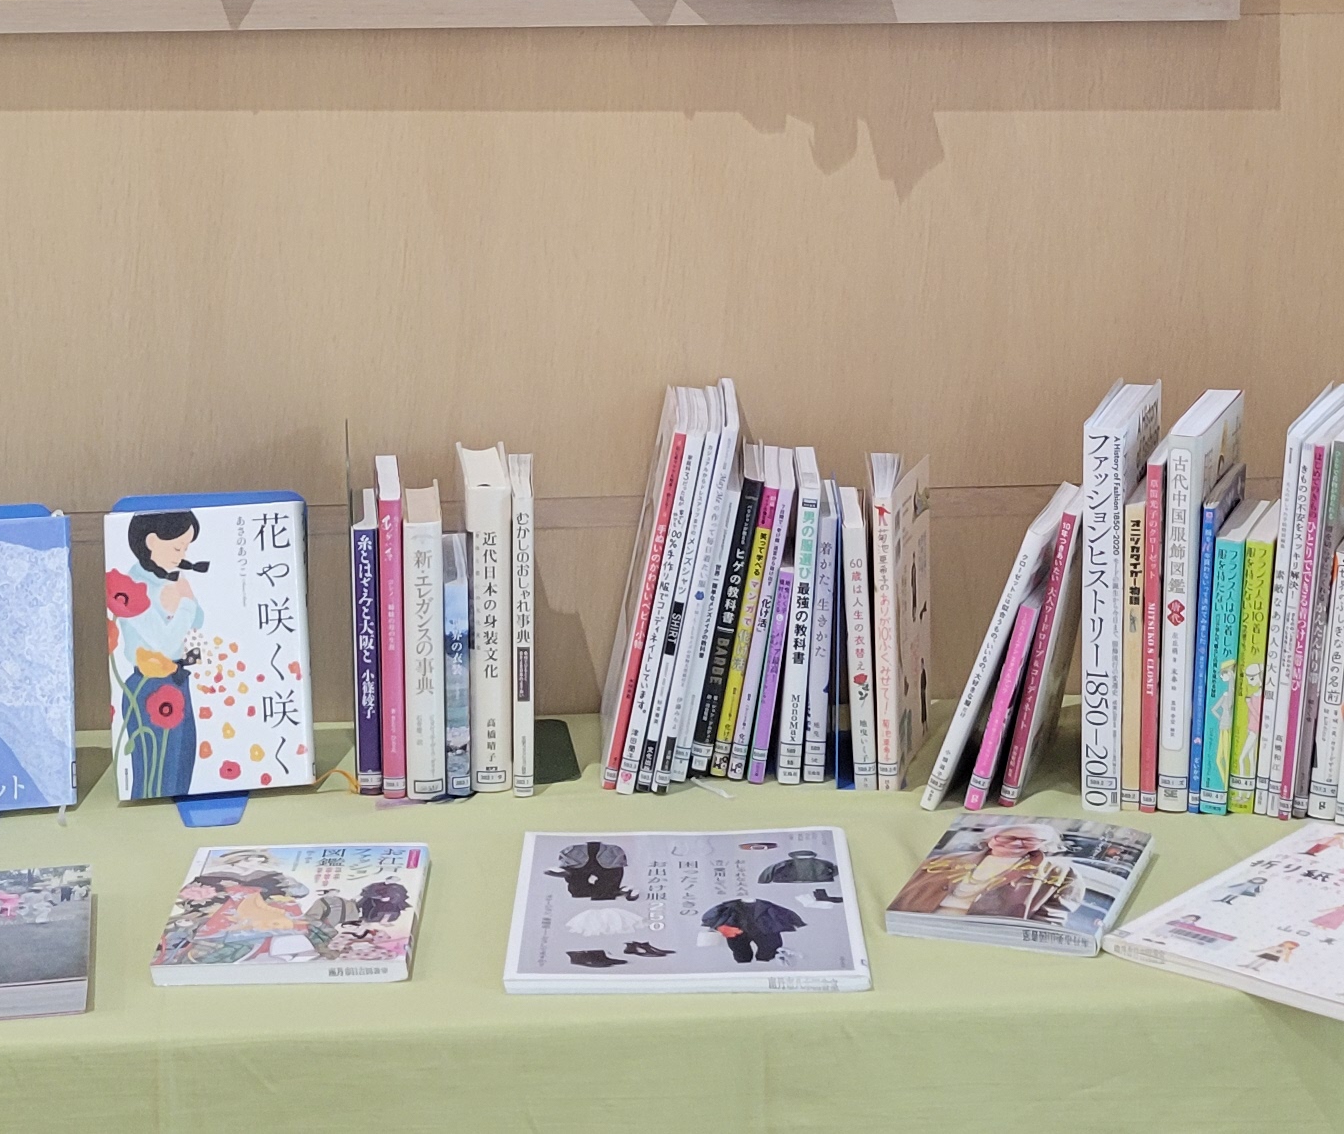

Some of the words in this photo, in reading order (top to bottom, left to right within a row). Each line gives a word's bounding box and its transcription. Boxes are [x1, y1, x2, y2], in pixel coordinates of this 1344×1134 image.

[1112, 443, 1121, 472] History
[1112, 472, 1121, 481] of
[1112, 481, 1121, 511] Fashion
[1167, 455, 1190, 595] 古代中国服飾図鑑
[235, 516, 249, 578] あさのあつこ
[753, 532, 768, 576] 笑って学べる
[799, 510, 816, 579] 男の服選び
[1084, 434, 1113, 669] ファッションヒストリー
[1112, 511, 1121, 556] 1850-2020
[1128, 519, 1143, 606] オニツカタイガー物語
[1289, 465, 1309, 600] きものの不安をスッキリ解決!
[516, 512, 531, 644] むかしのおしゃれ事典
[677, 536, 696, 596] メンズシャツ
[721, 548, 746, 629] ヒゲの教科書
[1214, 548, 1228, 612] 服を持たない
[1243, 547, 1256, 610] 服を持たない
[356, 534, 375, 664] 糸とはさみと大阪と
[413, 549, 435, 695] 新・エレガンスの事典
[482, 531, 499, 679] 近代日本の身装文化
[666, 612, 682, 646] SHIRT
[743, 580, 760, 626] マンガで
[792, 582, 811, 665] 最強の教科書
[815, 541, 833, 659] 着かた、生きかた
[850, 558, 866, 671] 60歳は人生の衣替え
[1222, 549, 1239, 658] フランス人は10着しか
[1250, 548, 1267, 655] フランス人は10着しか
[252, 513, 302, 776] 花や咲く咲く
[1264, 569, 1286, 701] 素敵なあの人の大人服
[1145, 657, 1155, 696] CLOSET
[486, 718, 497, 763] 高橋晴子
[789, 694, 801, 743] MonoMax
[859, 719, 869, 763] 地曳いく子
[319, 847, 346, 867] 図鑑
[378, 847, 407, 874] お江戸
[1276, 924, 1311, 937] 山口
